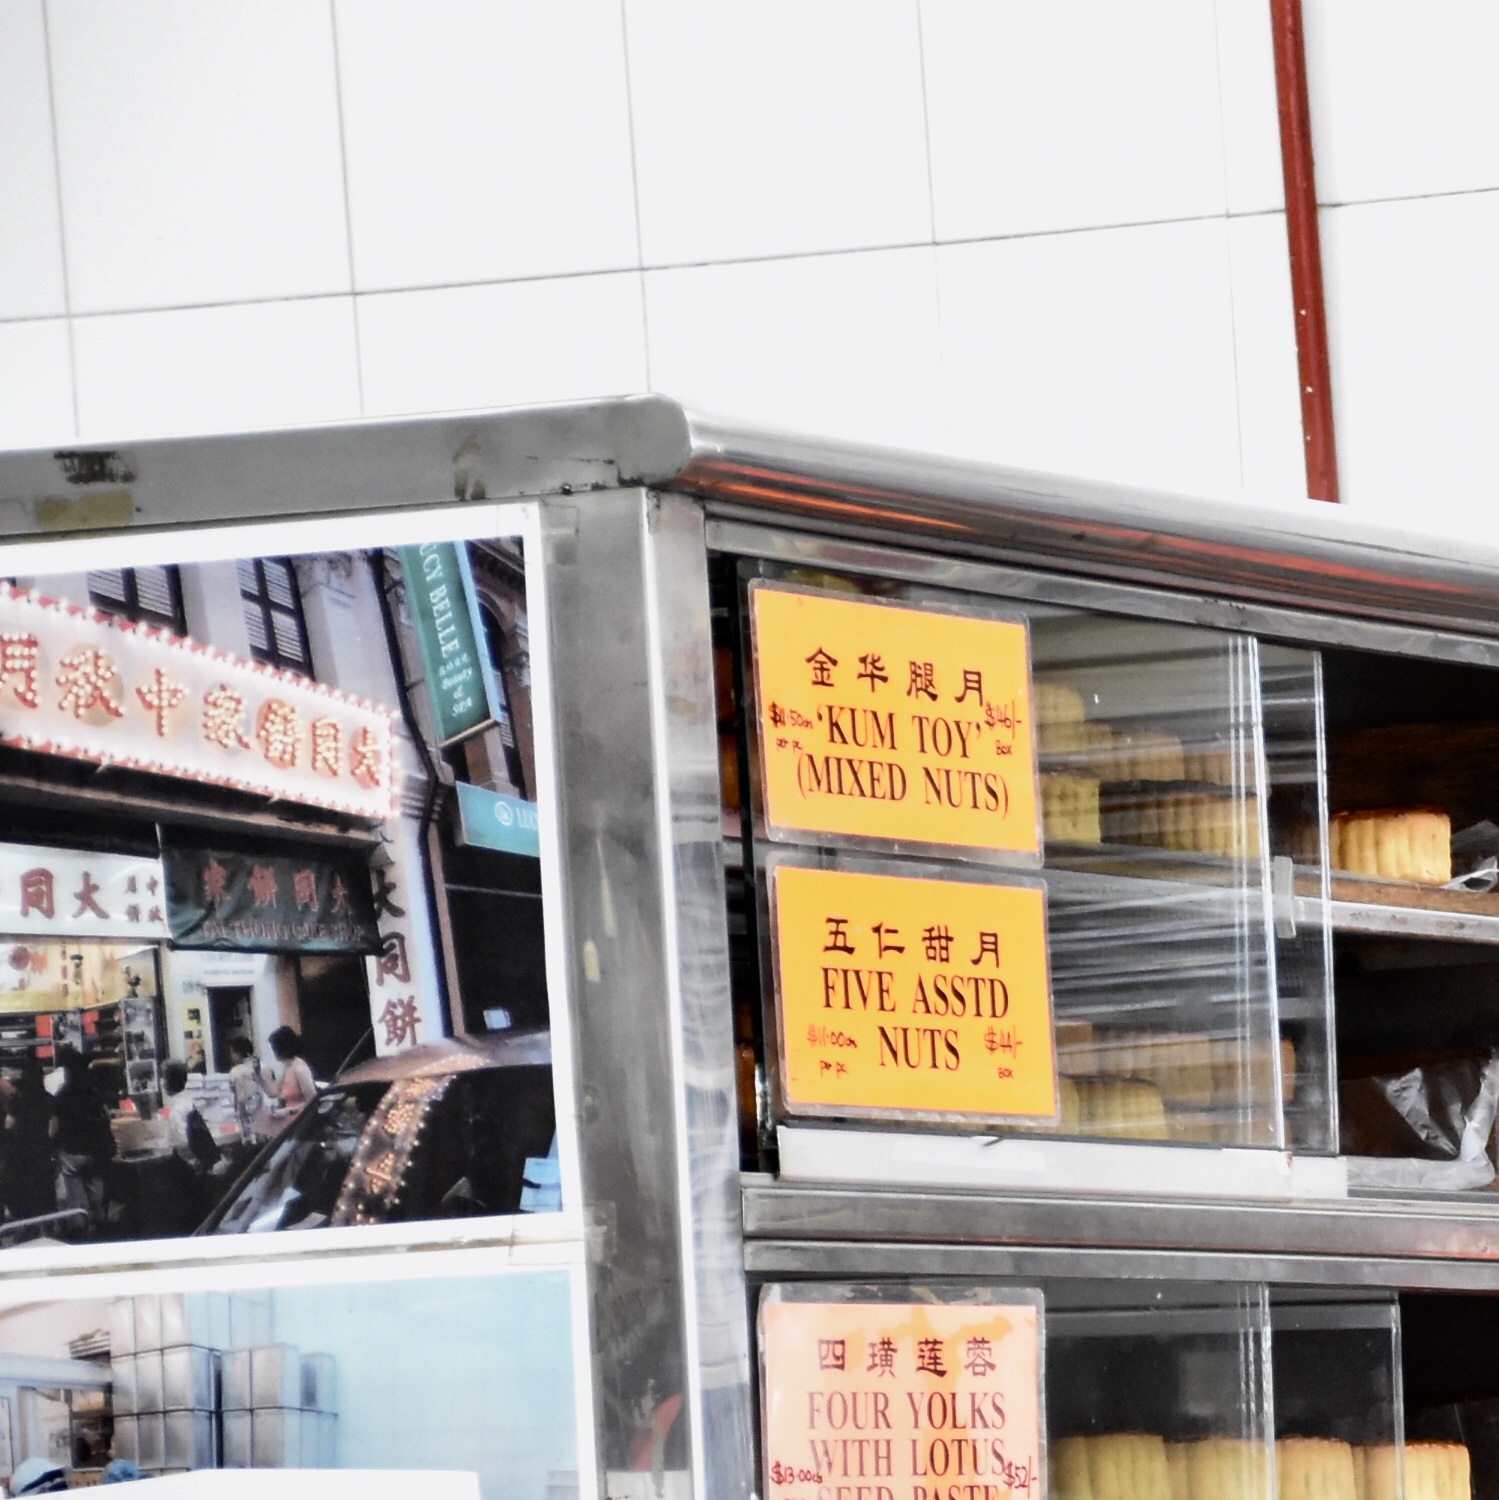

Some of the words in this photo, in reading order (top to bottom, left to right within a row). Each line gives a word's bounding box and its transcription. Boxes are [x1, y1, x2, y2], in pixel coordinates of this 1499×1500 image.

[430, 584, 459, 658] BELLE
[797, 754, 907, 801] (MIXED
[923, 767, 1009, 820] NUTS)
[823, 917, 1001, 969] 五仁甜月
[821, 967, 897, 1013] FIVE
[912, 973, 1009, 1019] ASSTD
[878, 1027, 961, 1071] NUTS
[807, 1391, 893, 1431] FOUR
[906, 1391, 1006, 1430] YOLKS
[809, 1438, 894, 1479] WITH
[910, 1437, 1005, 1476] LOTUS
